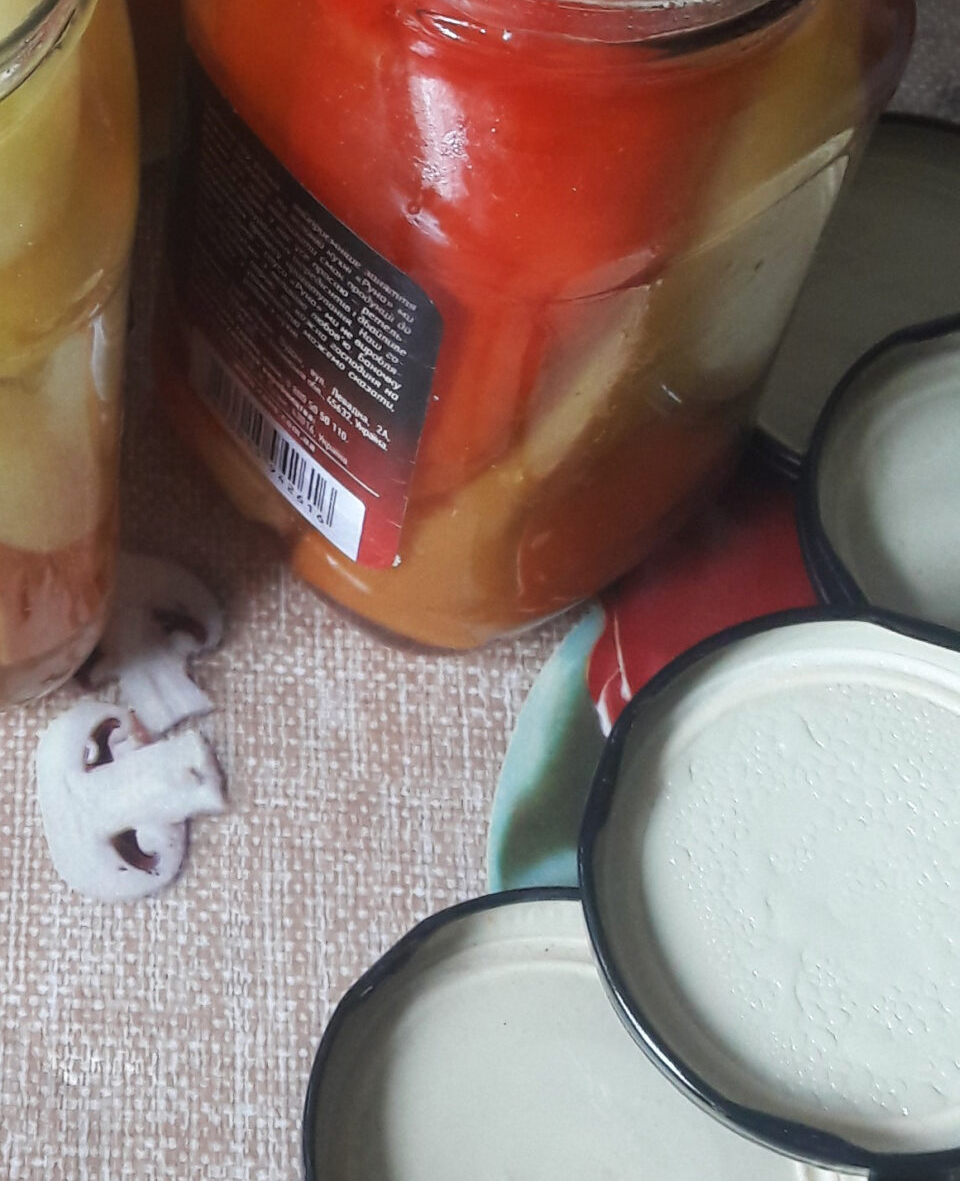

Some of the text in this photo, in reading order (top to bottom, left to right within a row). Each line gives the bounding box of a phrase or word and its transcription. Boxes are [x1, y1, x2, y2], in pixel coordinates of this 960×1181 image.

[312, 262, 349, 297] просто
[355, 274, 393, 308] «Руно»
[397, 309, 415, 324] ми
[324, 312, 340, 327] ми
[340, 326, 353, 340] не
[347, 281, 395, 322] продукції
[397, 321, 412, 335] до
[357, 315, 407, 357] дбайливе
[358, 328, 383, 351] Наш
[303, 330, 346, 371] можемо
[347, 370, 395, 413] сказати,
[329, 343, 382, 389] господиня
[384, 388, 400, 402] на
[357, 352, 402, 391] Баночку
[319, 411, 331, 426] 50
